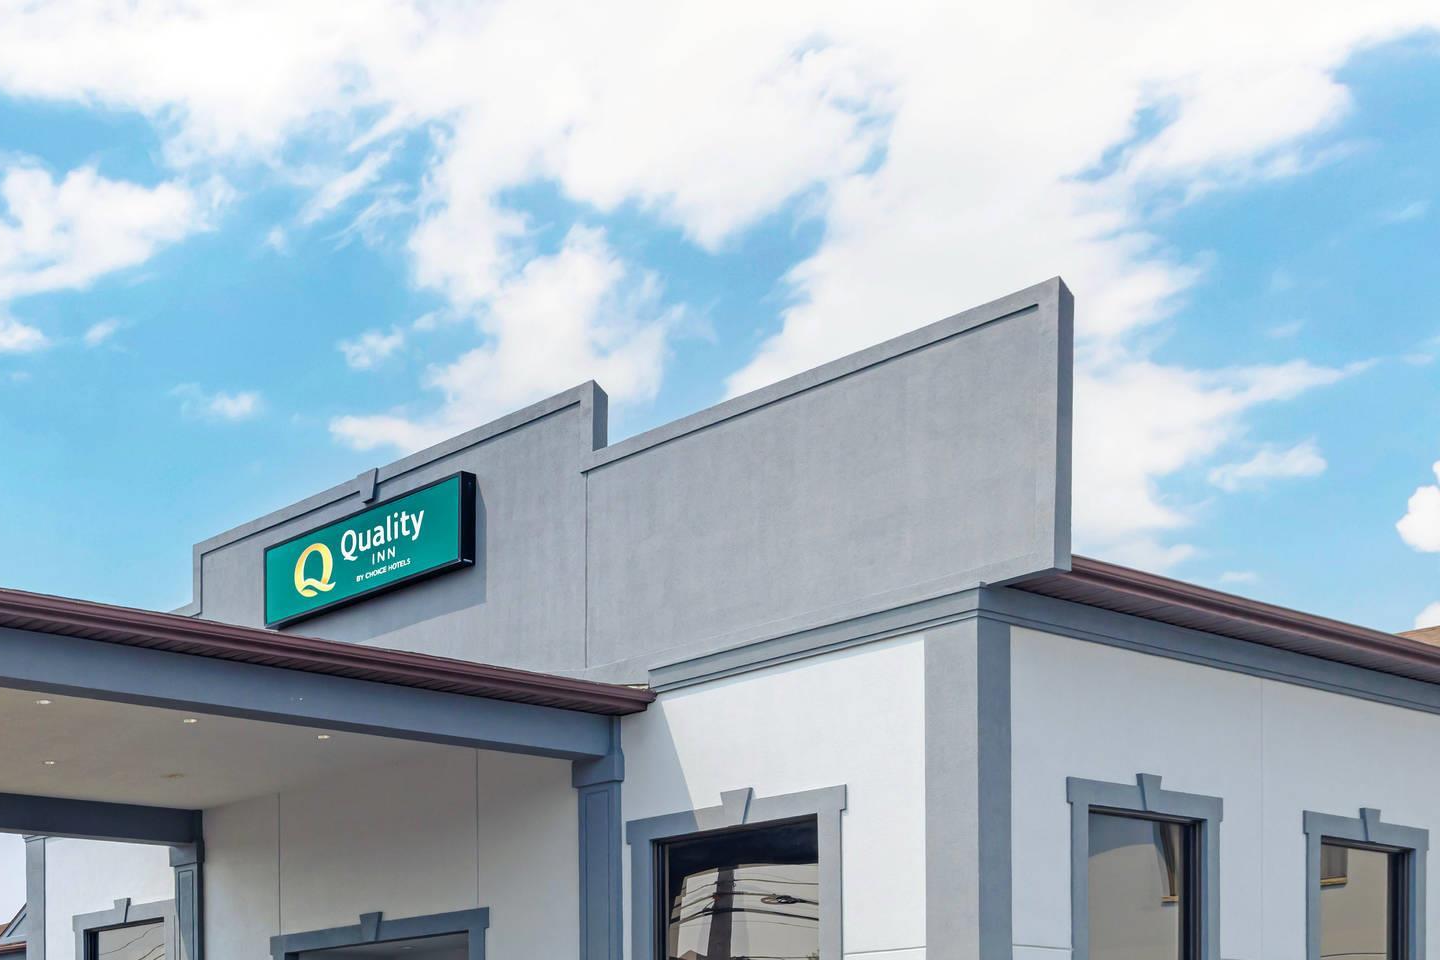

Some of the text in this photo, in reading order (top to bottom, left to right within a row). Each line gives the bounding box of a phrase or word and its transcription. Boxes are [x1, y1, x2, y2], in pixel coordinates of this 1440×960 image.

[341, 510, 425, 561] Quality
[294, 543, 336, 598] Q
[356, 558, 411, 582] BY CHOICE HOTELS
[372, 546, 396, 565] INN
